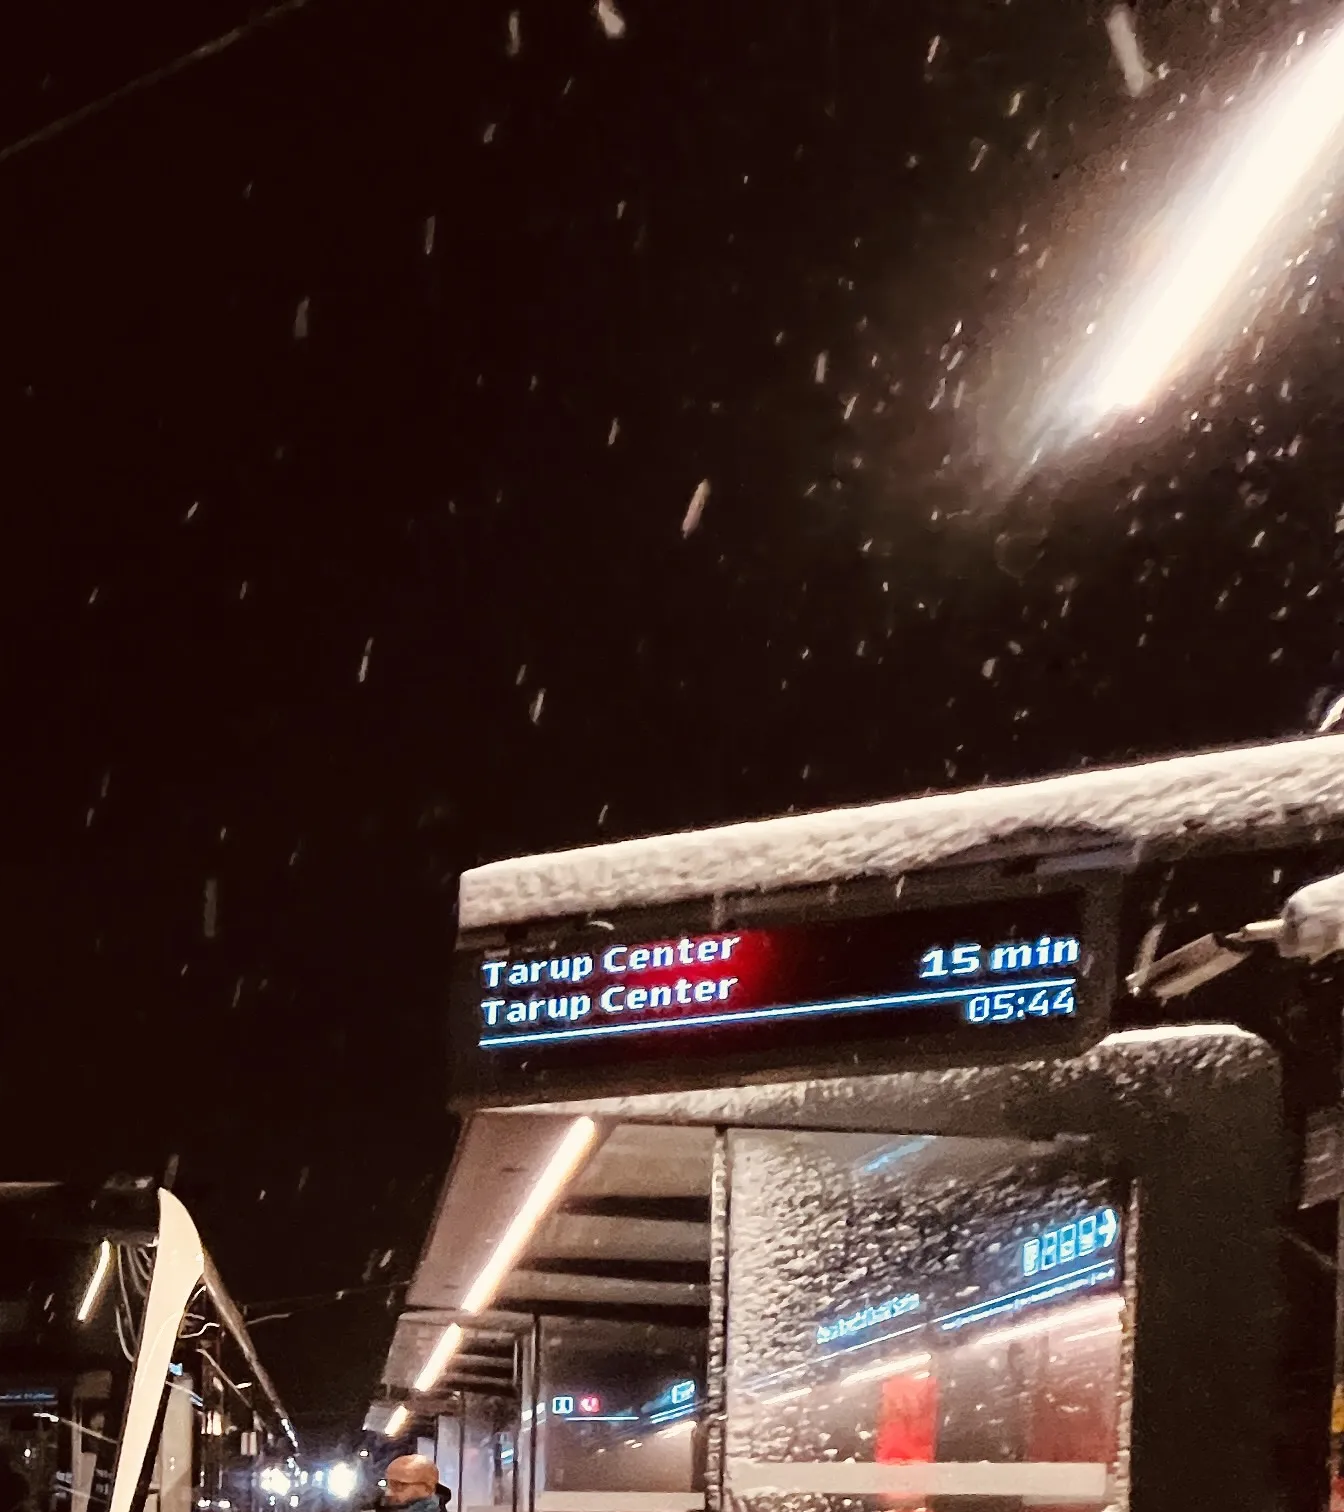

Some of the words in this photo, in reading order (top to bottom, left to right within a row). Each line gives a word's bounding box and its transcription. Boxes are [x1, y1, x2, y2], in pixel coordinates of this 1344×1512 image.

[482, 954, 593, 989] Tarup
[602, 932, 741, 974] Center
[921, 941, 981, 979] 15
[990, 934, 1080, 968] min
[480, 994, 592, 1026] Tarup
[599, 973, 739, 1014] Center
[967, 986, 1076, 1023] 05:44
